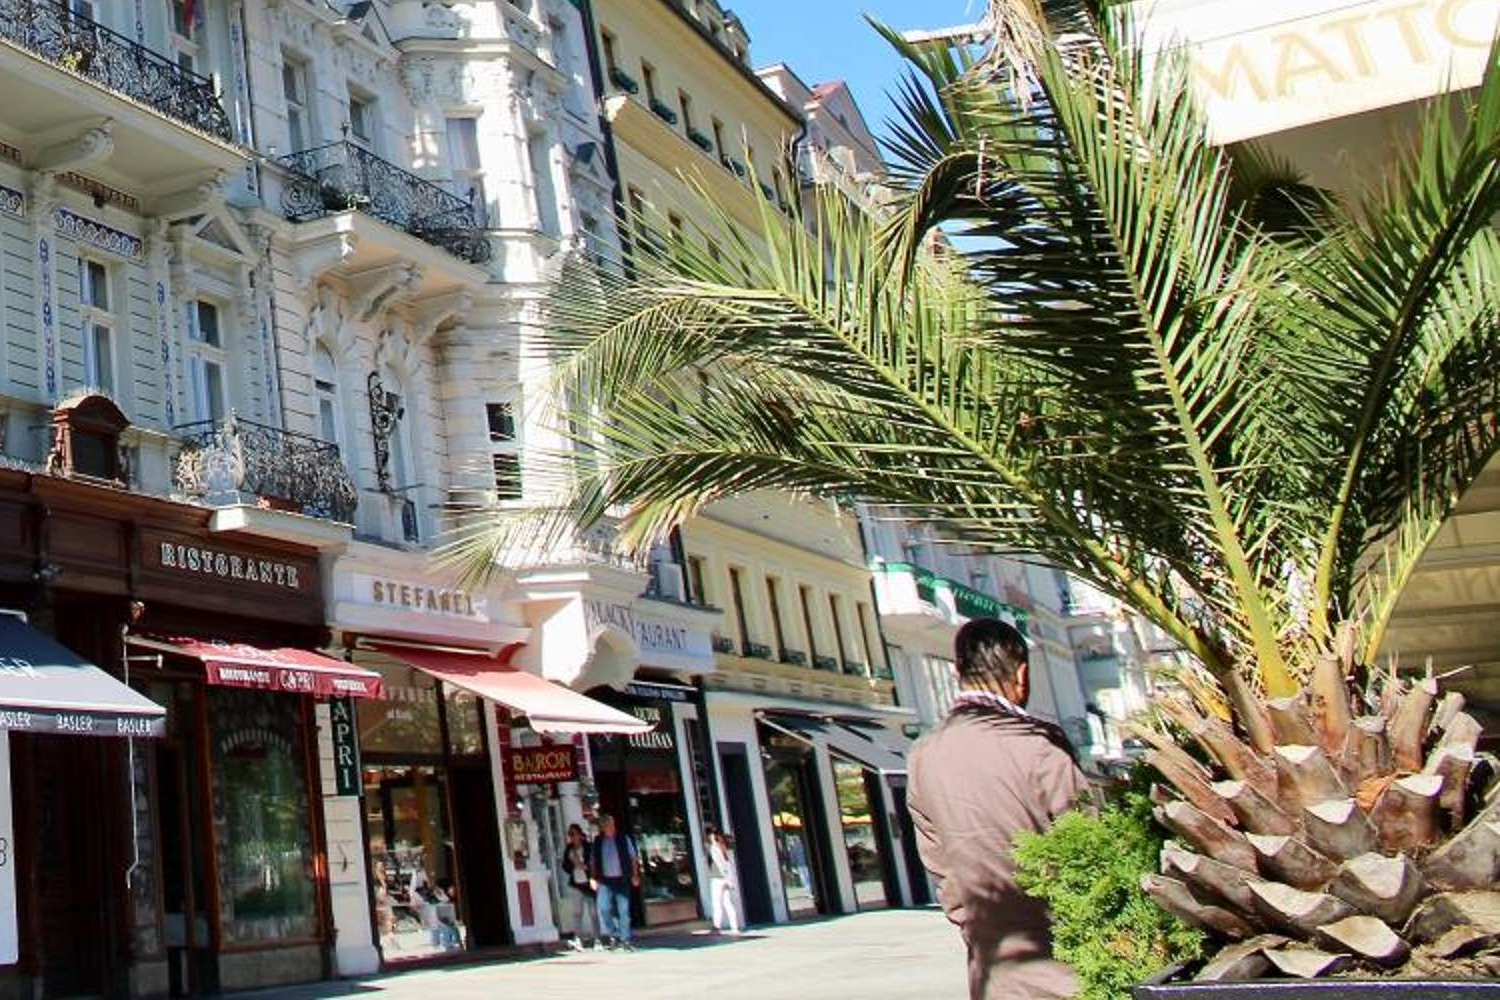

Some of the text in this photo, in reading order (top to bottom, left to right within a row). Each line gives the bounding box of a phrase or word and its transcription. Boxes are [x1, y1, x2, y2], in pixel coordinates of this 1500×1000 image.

[161, 543, 299, 587] RISTORANTE
[373, 580, 476, 616] STEFANEL
[280, 669, 315, 691] CAPRI
[56, 713, 93, 732] BASLER
[117, 717, 151, 735] BASLER
[333, 695, 353, 789] APRI
[512, 751, 571, 771] BARON
